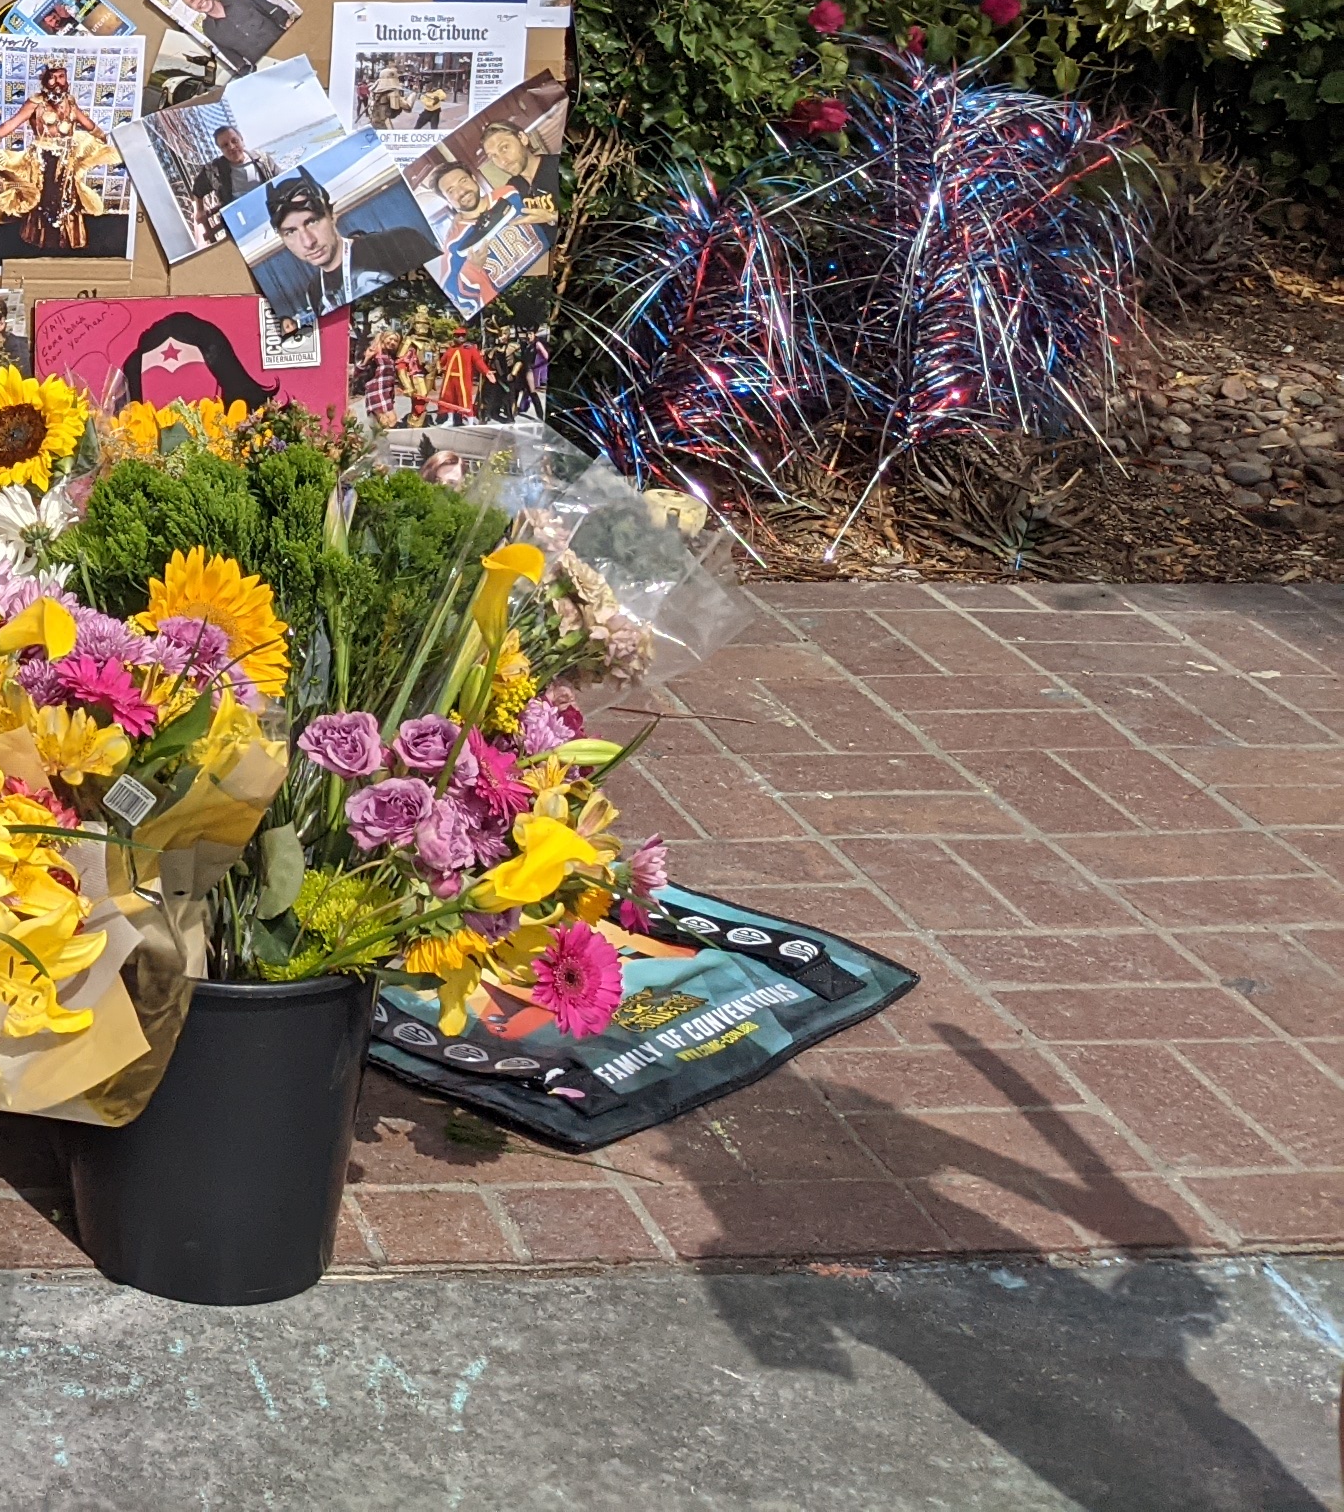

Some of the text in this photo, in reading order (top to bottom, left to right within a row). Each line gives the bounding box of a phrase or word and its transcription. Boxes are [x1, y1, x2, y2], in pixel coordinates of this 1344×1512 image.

[410, 14, 455, 24] The San Diego
[375, 23, 489, 42] Union-Tribune
[380, 133, 409, 143] OF THE
[265, 353, 316, 365] INTERNATIONAL
[593, 1040, 664, 1085] FAMILY
[656, 1028, 687, 1050] OF
[680, 982, 800, 1041] CONVENTIONS
